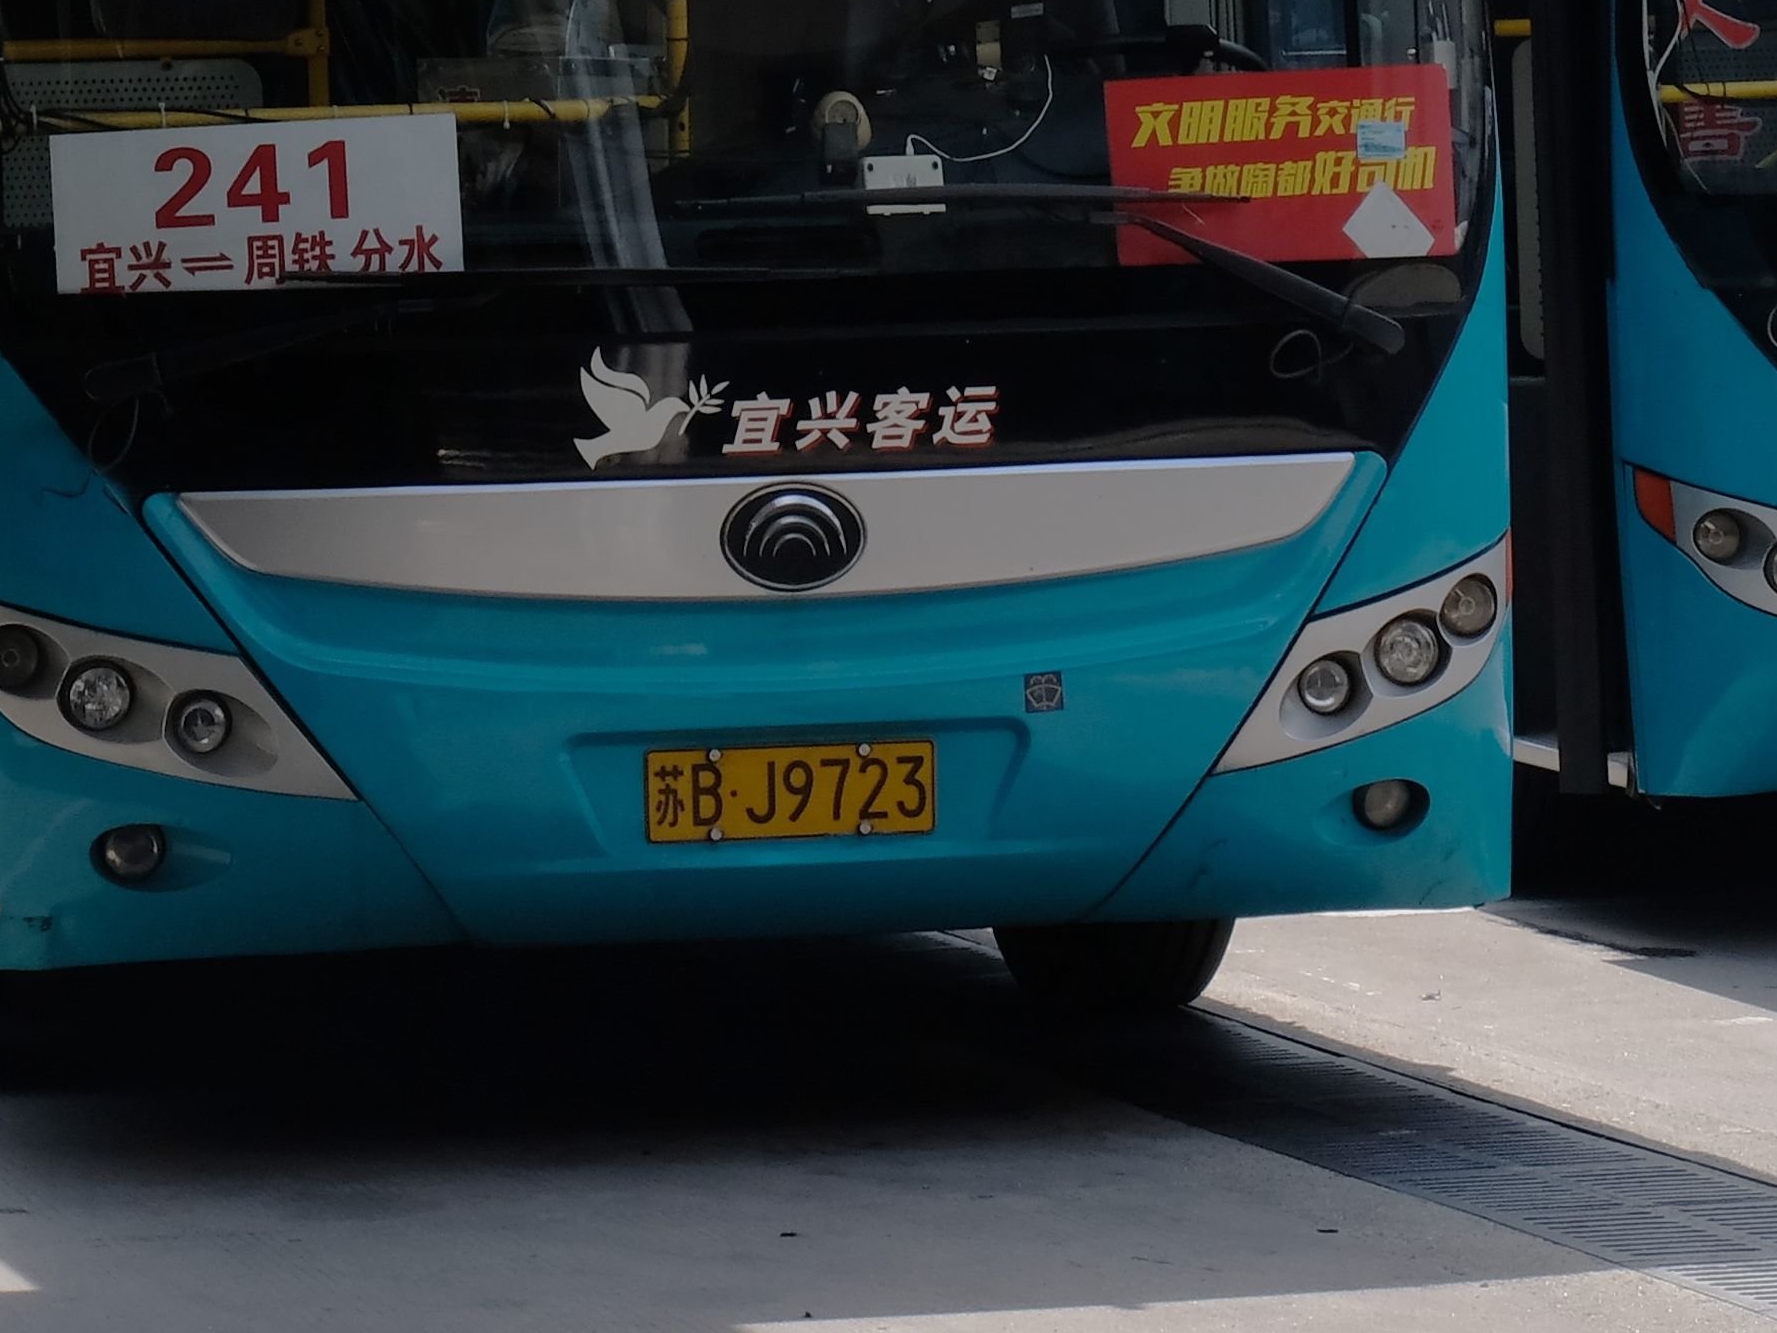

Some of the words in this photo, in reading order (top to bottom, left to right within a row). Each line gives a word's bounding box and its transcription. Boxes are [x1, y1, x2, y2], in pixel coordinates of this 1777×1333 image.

[1131, 95, 1416, 148] 文明服务交通行
[154, 140, 349, 229] 241
[1167, 145, 1437, 199] 争做陶都好司机
[80, 240, 173, 296] 宜兴
[244, 229, 336, 286] 周铁
[350, 225, 444, 273] 分水
[722, 385, 1001, 457] 宜兴客运
[654, 755, 927, 827] 苏B·J9723
